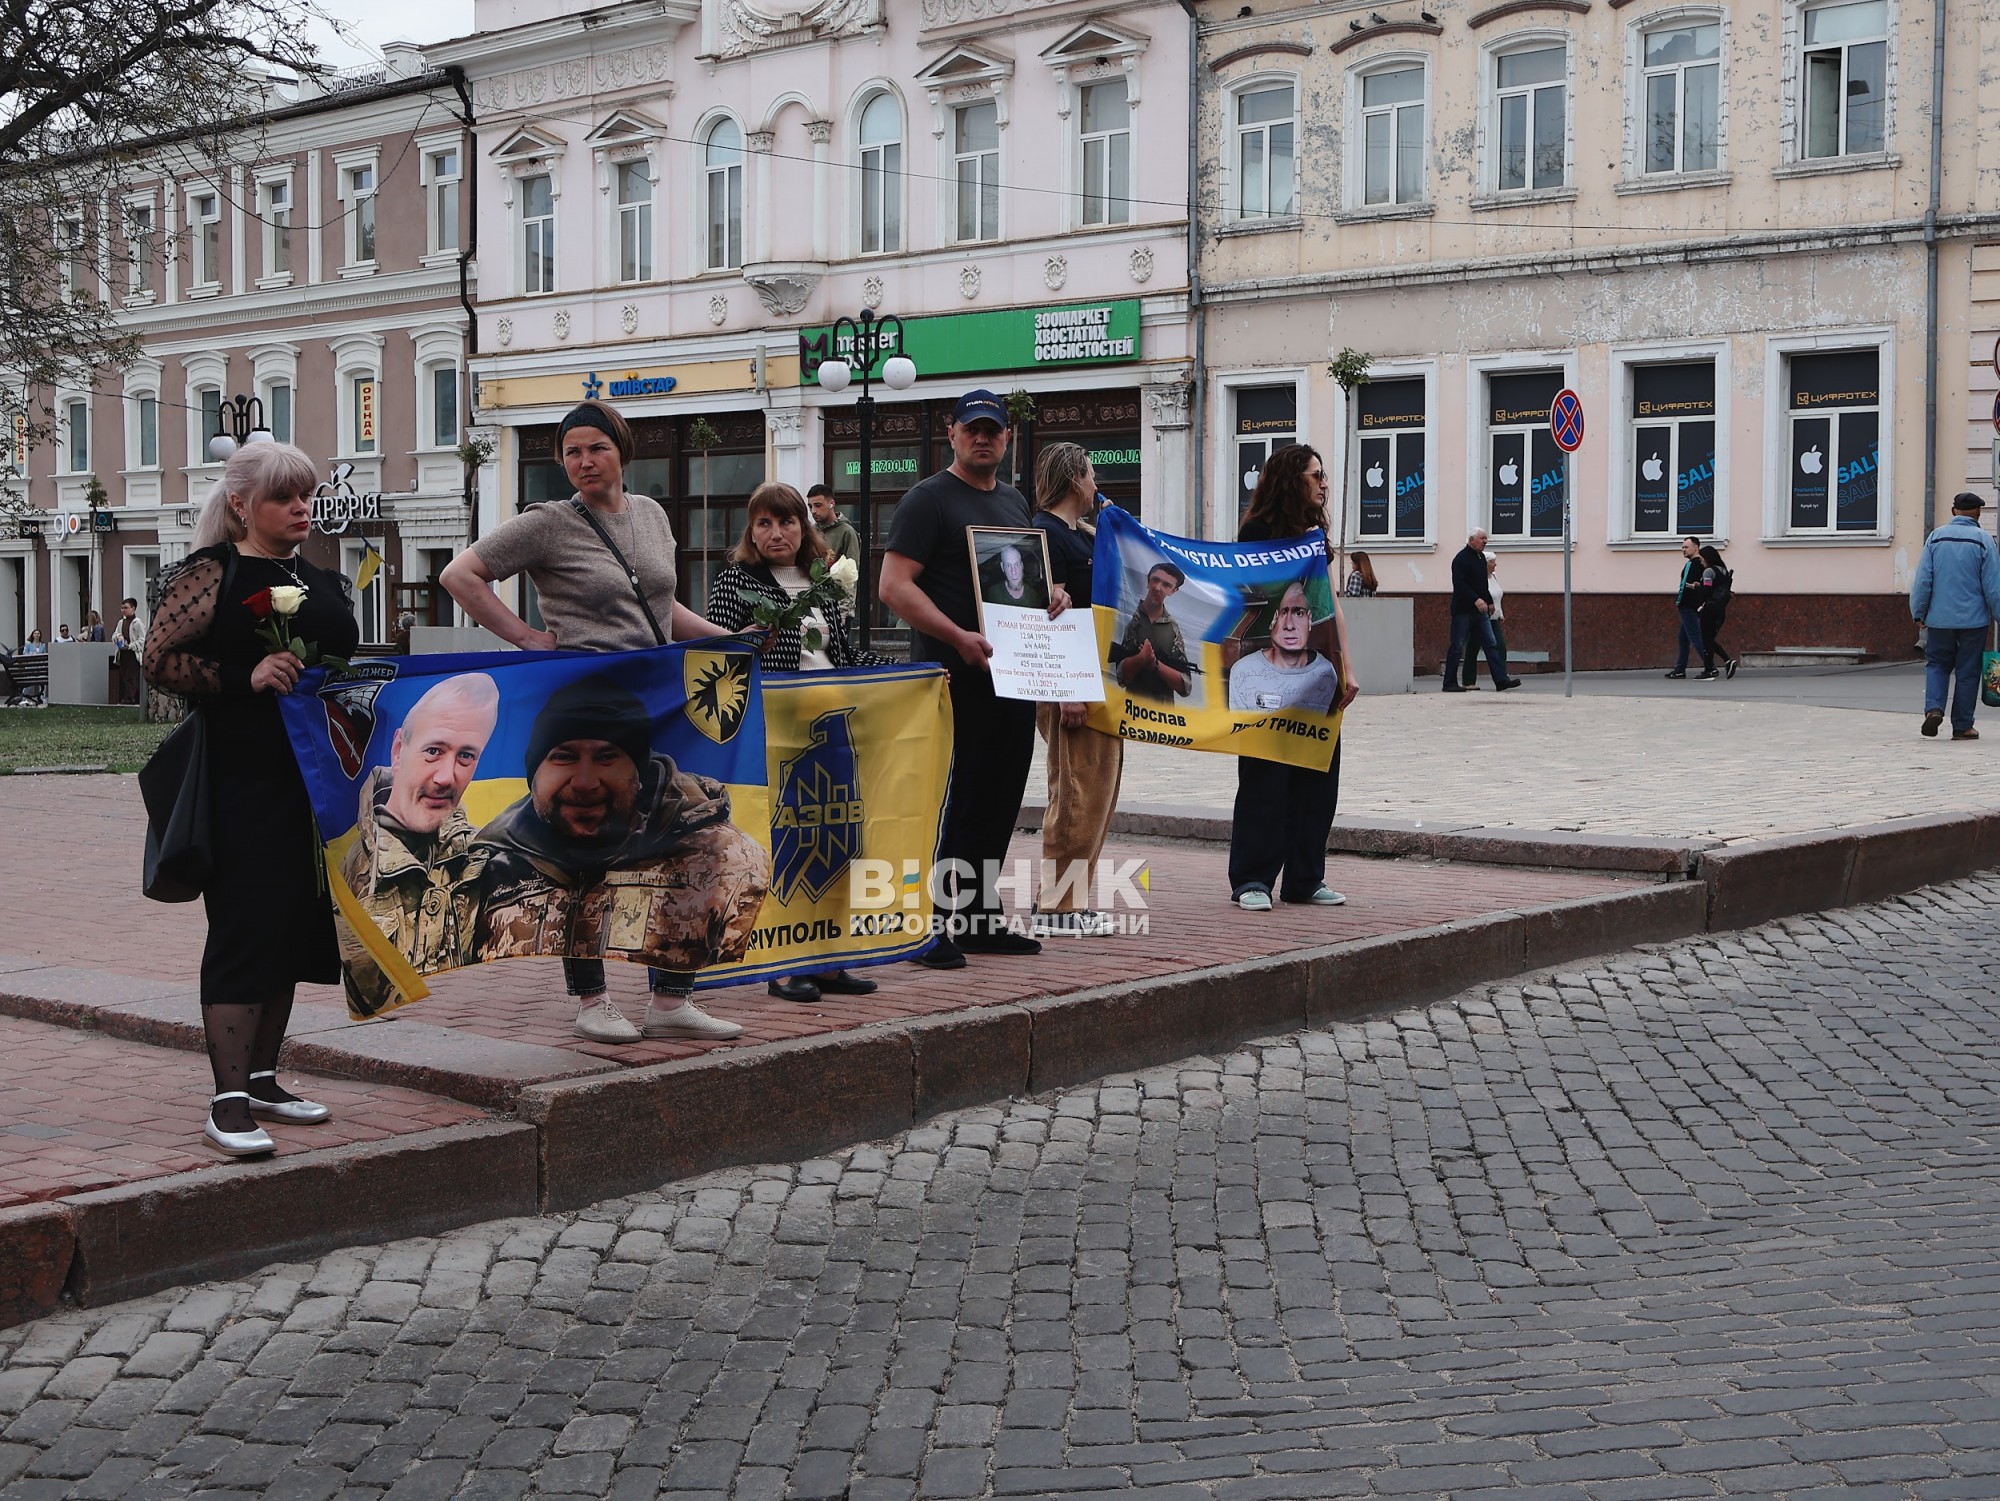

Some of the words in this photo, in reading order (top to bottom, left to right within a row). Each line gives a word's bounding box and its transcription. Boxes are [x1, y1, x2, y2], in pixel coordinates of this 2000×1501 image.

[1034, 308, 1112, 328] ЗООМАРКЕТ
[1034, 325, 1108, 345] ХВОСТАТИХ
[1034, 336, 1134, 360] ОСОБИСТОСТЕЙ
[609, 371, 677, 397] КИЇВСТАР
[1810, 391, 1877, 403] ЦИФРОТЕХ
[362, 386, 372, 437] ОРЕНДА
[1507, 410, 1551, 419] ЦИФРОТ
[1651, 401, 1713, 412] ЦИФРОТЕХ
[1252, 420, 1296, 429] ЦИФРОТЕ
[1396, 470, 1424, 496] SAL
[1531, 465, 1564, 494] SAL
[311, 494, 382, 523] ДРЕРІЯ
[1396, 491, 1424, 518] SAL
[1532, 487, 1563, 516] SAL
[22, 524, 38, 535] glo
[53, 508, 82, 543] glo
[997, 620, 1019, 630] РОМАН
[1019, 622, 1077, 632] ВОЛОДИМИРОВИЧ
[1125, 698, 1187, 727] Ярослав
[1269, 717, 1330, 741] ТРИВАЄ
[775, 799, 865, 829] АЗОВ
[850, 911, 904, 937] 2022
